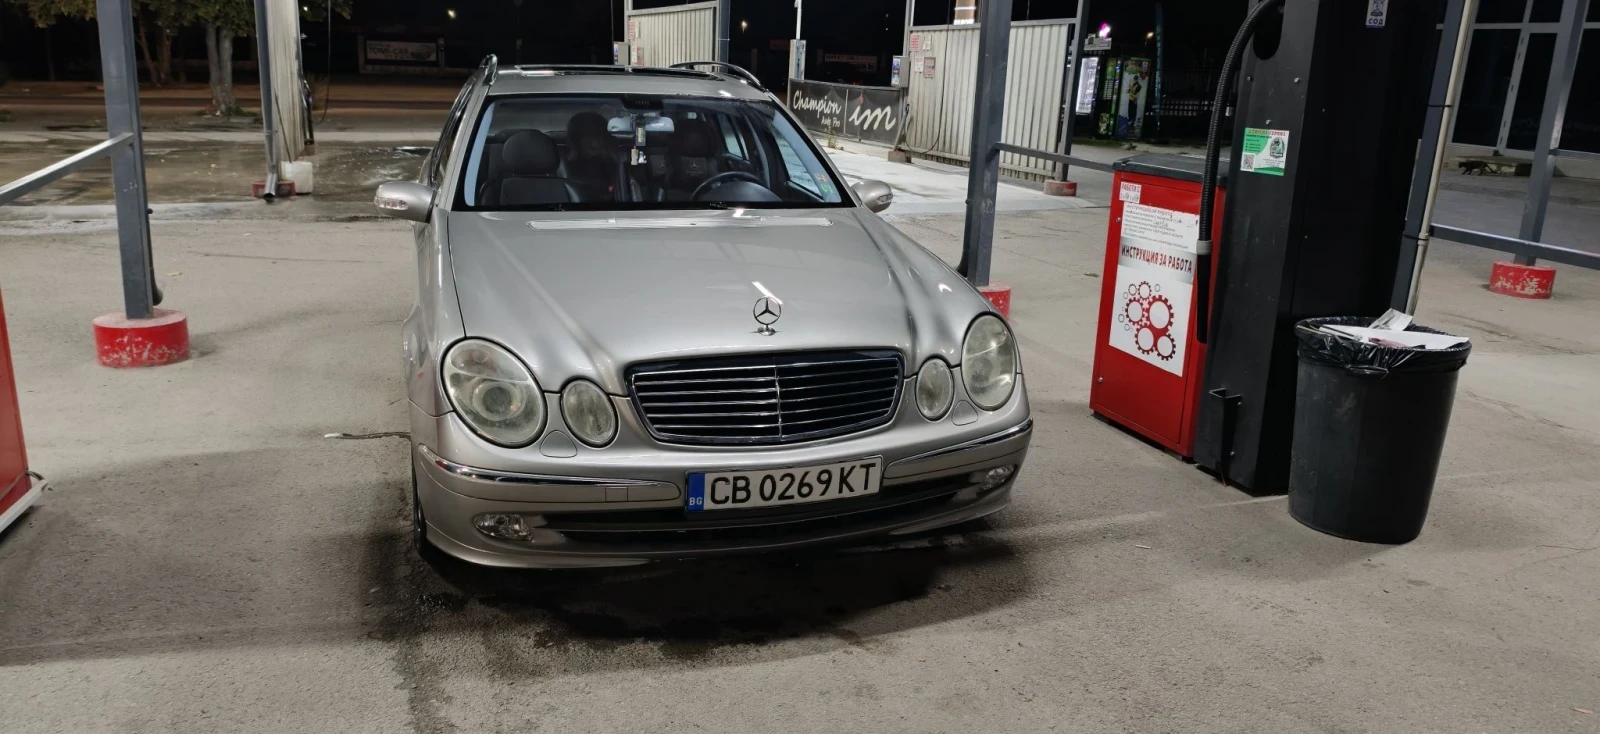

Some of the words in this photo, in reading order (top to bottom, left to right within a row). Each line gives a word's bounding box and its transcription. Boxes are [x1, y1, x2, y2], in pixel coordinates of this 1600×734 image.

[793, 90, 842, 119] Champion
[1121, 245, 1158, 265] ИНСТРУКЦИЯ
[1159, 254, 1167, 266] ЗА
[1168, 255, 1192, 273] РАБОТА
[710, 475, 751, 505] CB
[759, 468, 833, 502] 0269
[838, 463, 876, 495] KT
[688, 496, 703, 506] BG
